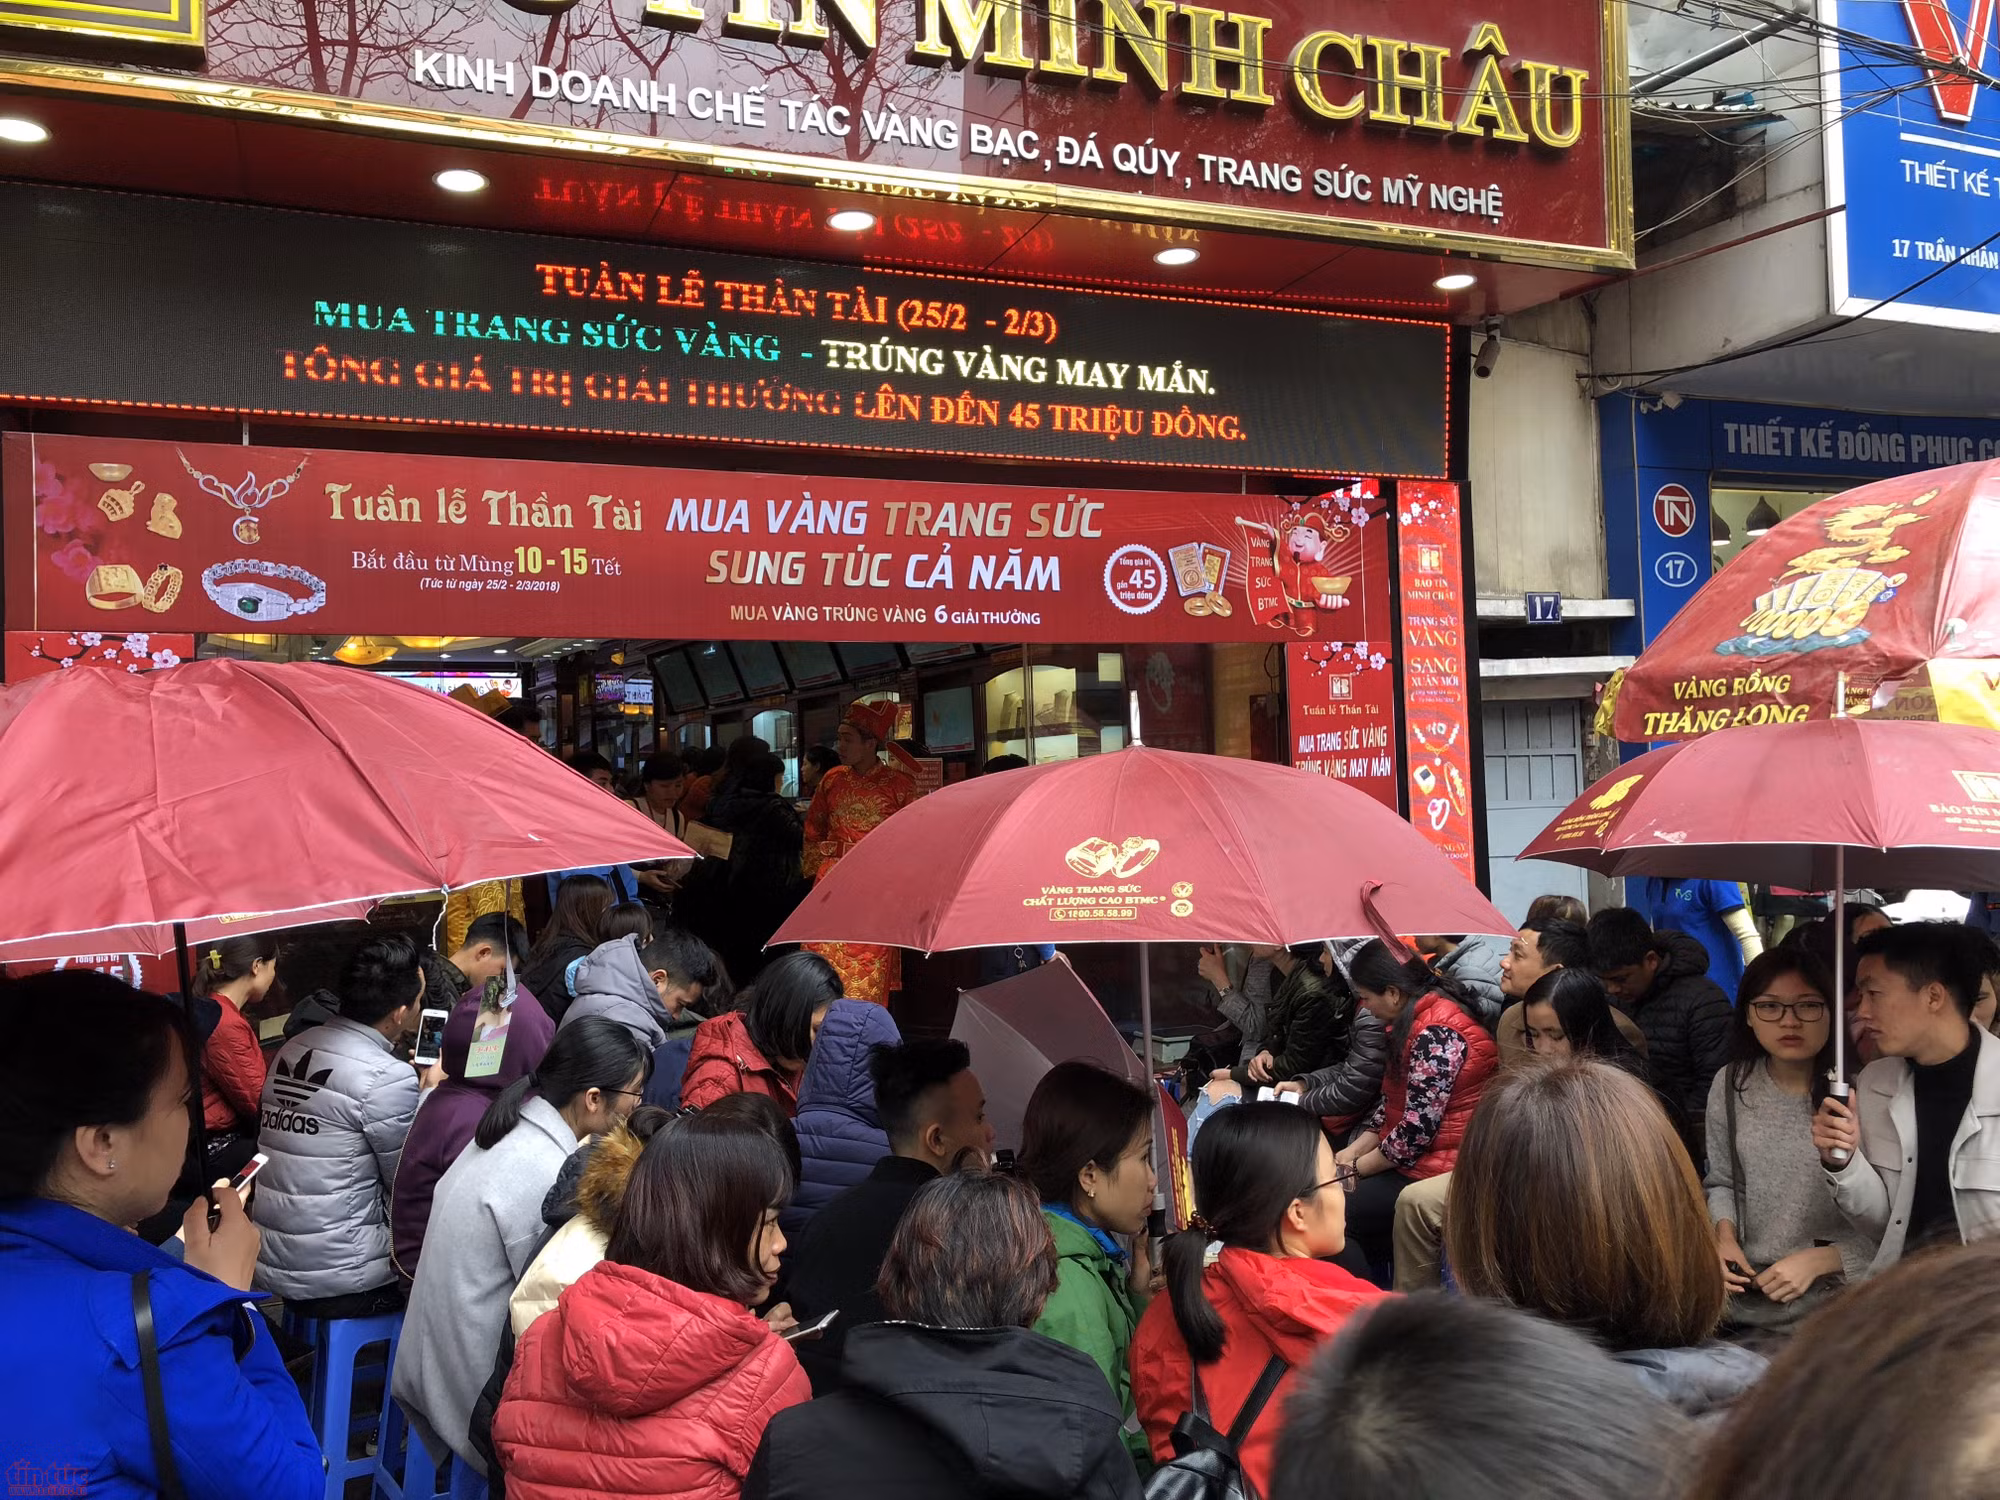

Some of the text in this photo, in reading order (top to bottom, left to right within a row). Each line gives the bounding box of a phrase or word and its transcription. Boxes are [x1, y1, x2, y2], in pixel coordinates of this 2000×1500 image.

[911, 0, 1275, 106] MINH
[1287, 21, 1590, 149] CHÂU
[414, 49, 514, 96] KINH
[531, 65, 676, 117] DOANH
[687, 83, 769, 127] CHẾ
[779, 94, 851, 137] TÁC
[862, 103, 959, 150] VÀNG
[1197, 152, 1303, 193] TRANG
[1313, 163, 1373, 201] SỨC
[1382, 173, 1424, 207] MỸ
[1430, 183, 1504, 223] NGHỆ
[1900, 159, 1960, 190] THIẾT
[1963, 168, 1991, 197] KẾ
[1892, 236, 1999, 270] 17 TRẦN NHÂN
[826, 285, 889, 323] TÀI
[897, 299, 967, 332] (25/2
[1004, 308, 1058, 344] 2/3)
[313, 300, 416, 334] MUA
[425, 307, 571, 345] TRANG
[580, 312, 662, 352] SỨC
[673, 320, 781, 361] VÀNG
[820, 336, 944, 376] TRÚNG
[952, 345, 1048, 384] VÀNG
[1056, 359, 1130, 390] MAY
[1137, 360, 1216, 395] MẮN.
[503, 365, 573, 407] TRỊ
[854, 382, 922, 422] LÊN
[930, 390, 1000, 427] ĐẾN
[1008, 402, 1042, 429] 45
[1048, 404, 1144, 441] TRIỆU
[1152, 405, 1247, 441] ĐỒNG.
[1723, 416, 1795, 457] THIẾT
[1800, 420, 1835, 459] KẾ
[1838, 422, 1906, 463] ĐỒNG
[323, 482, 643, 532] Tuần lễ Thần Tài
[665, 491, 1105, 539] MUA VÀNG TRANG SỨC
[1250, 536, 1270, 548] VÀNG
[351, 549, 387, 569] Bắt
[392, 549, 429, 571] đầu
[434, 552, 456, 571] từ
[459, 553, 514, 577] Mùng
[514, 546, 543, 574] 10
[561, 547, 588, 575] 15
[591, 556, 622, 576] Tết
[705, 542, 1061, 592] SUNG TÚC CẢ NĂM
[1250, 556, 1273, 567] TRANG
[1665, 559, 1685, 580] 17
[420, 576, 444, 591] (Tức
[446, 577, 457, 590] từ
[457, 578, 484, 592] ngày
[486, 578, 507, 591] 25/2
[516, 579, 560, 593] 2/3/2018)
[1129, 569, 1156, 589] 45
[1255, 575, 1272, 588] SỨC
[730, 602, 1041, 626] MUA VÀNG TRÚNG VÀNG 6 GIẢI THƯỞNG
[1258, 596, 1279, 611] BTMC
[1407, 616, 1438, 627] TRANG
[1408, 625, 1457, 647] VÀNG
[1410, 657, 1457, 674] SANG
[1673, 668, 1792, 700] VÀNG RỒNG
[1644, 704, 1731, 736] THĂNG
[1298, 722, 1387, 754] MUA TRANG SỨC VÀNG
[1324, 754, 1347, 778] VÀNG
[1349, 757, 1369, 778] MAY
[1370, 749, 1391, 777] MẮN
[1022, 895, 1158, 907] CHẤT LƯỢNG CAO BTMC
[1041, 883, 1142, 895] VÀNG TRANG SỨC
[261, 1108, 320, 1136] adidas
